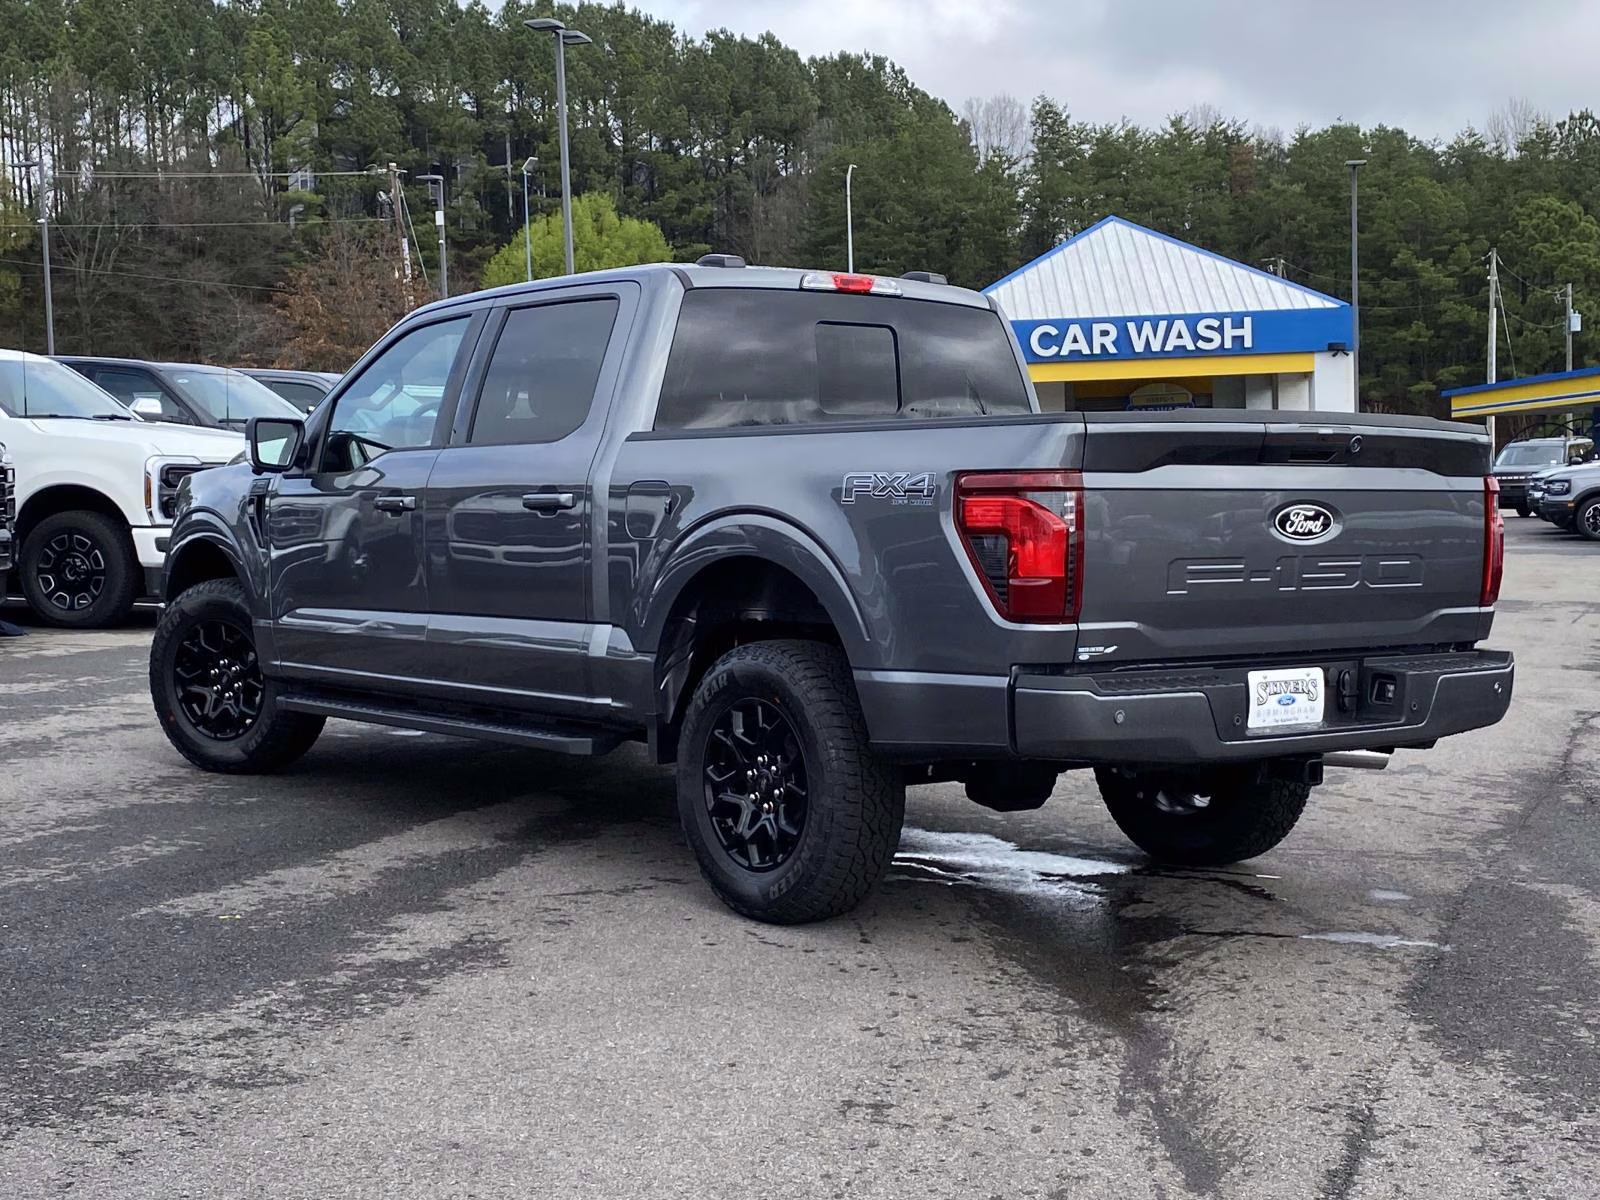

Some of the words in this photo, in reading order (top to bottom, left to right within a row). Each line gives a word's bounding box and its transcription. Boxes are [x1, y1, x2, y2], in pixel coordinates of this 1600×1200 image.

[1030, 323, 1118, 357] CAR
[1127, 317, 1252, 353] WASH
[841, 472, 936, 504] FX4
[1286, 509, 1324, 533] Ford
[1167, 554, 1424, 595] F-150
[1257, 679, 1318, 706] STIVERS
